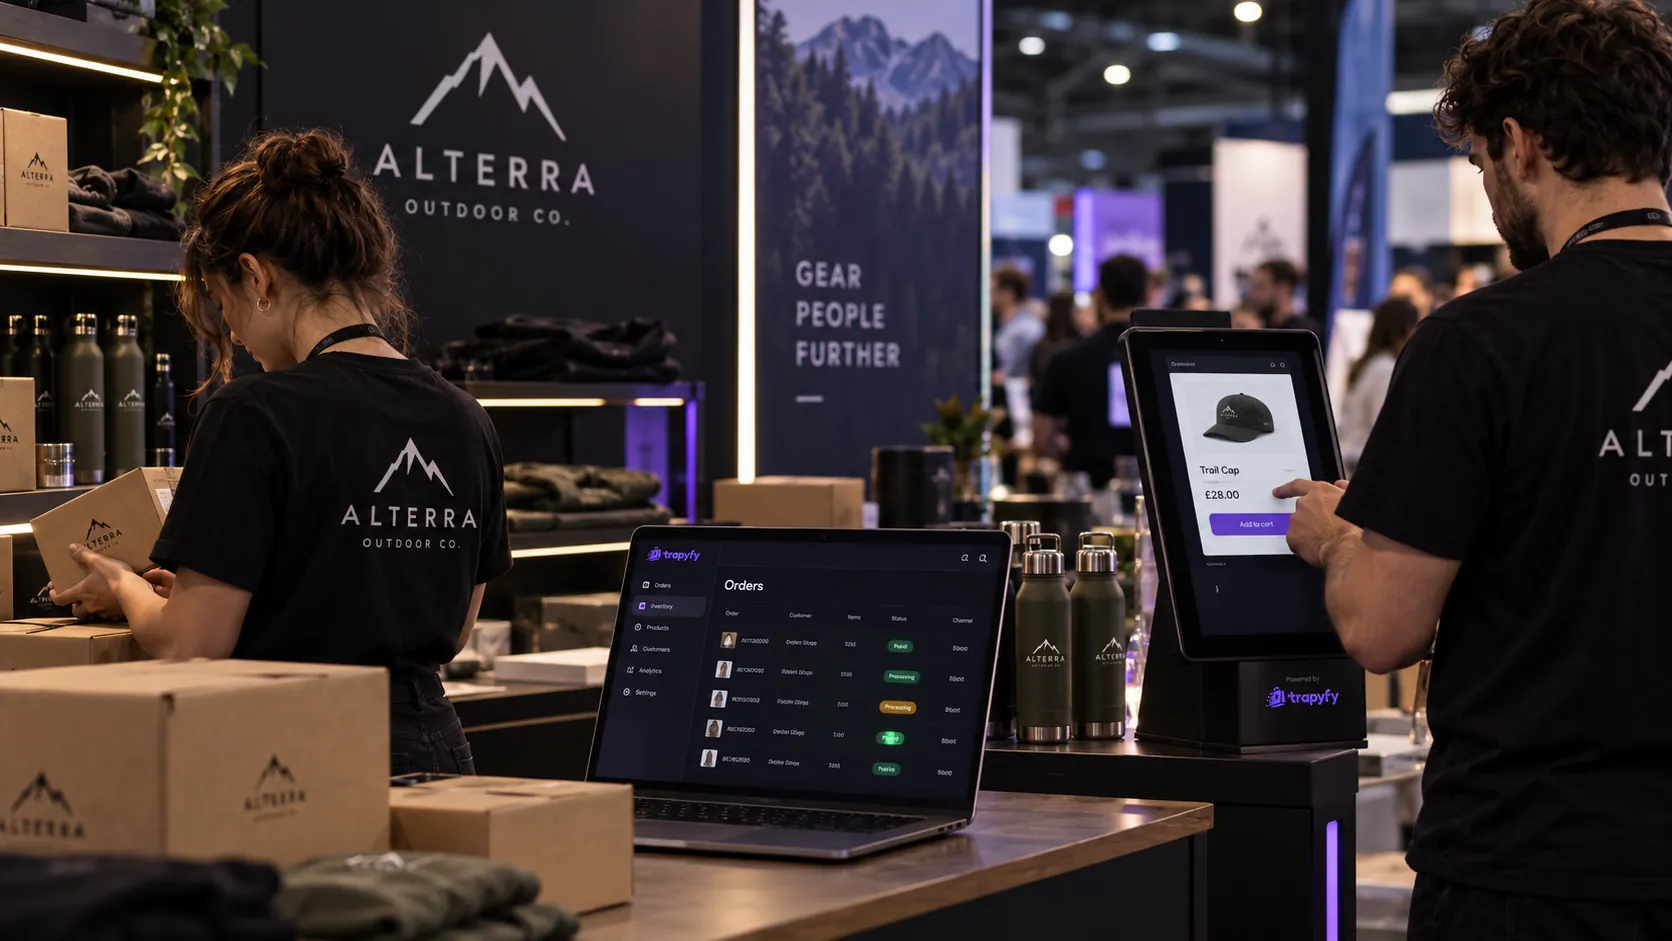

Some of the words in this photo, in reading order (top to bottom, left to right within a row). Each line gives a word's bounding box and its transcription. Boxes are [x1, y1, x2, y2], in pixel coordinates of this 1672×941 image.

[373, 143, 595, 195] ALTERRA
[405, 199, 518, 221] OUTDOOR
[534, 209, 569, 225] CO.
[796, 260, 861, 287] GEAR
[796, 301, 884, 328] PEOPLE
[796, 341, 899, 367] FURTHER
[1199, 465, 1220, 475] Trail
[1221, 466, 1239, 476] Cap
[1204, 490, 1240, 500] £28.00
[341, 505, 476, 528] ALTERRA
[84, 529, 122, 550] LTERRA
[363, 538, 430, 548] OUTDOOR
[440, 539, 460, 548] CO.
[663, 550, 700, 561] trapyfy
[725, 580, 763, 590] Orders
[1025, 655, 1065, 663] ALTERRA
[1288, 689, 1338, 705] trapyfy
